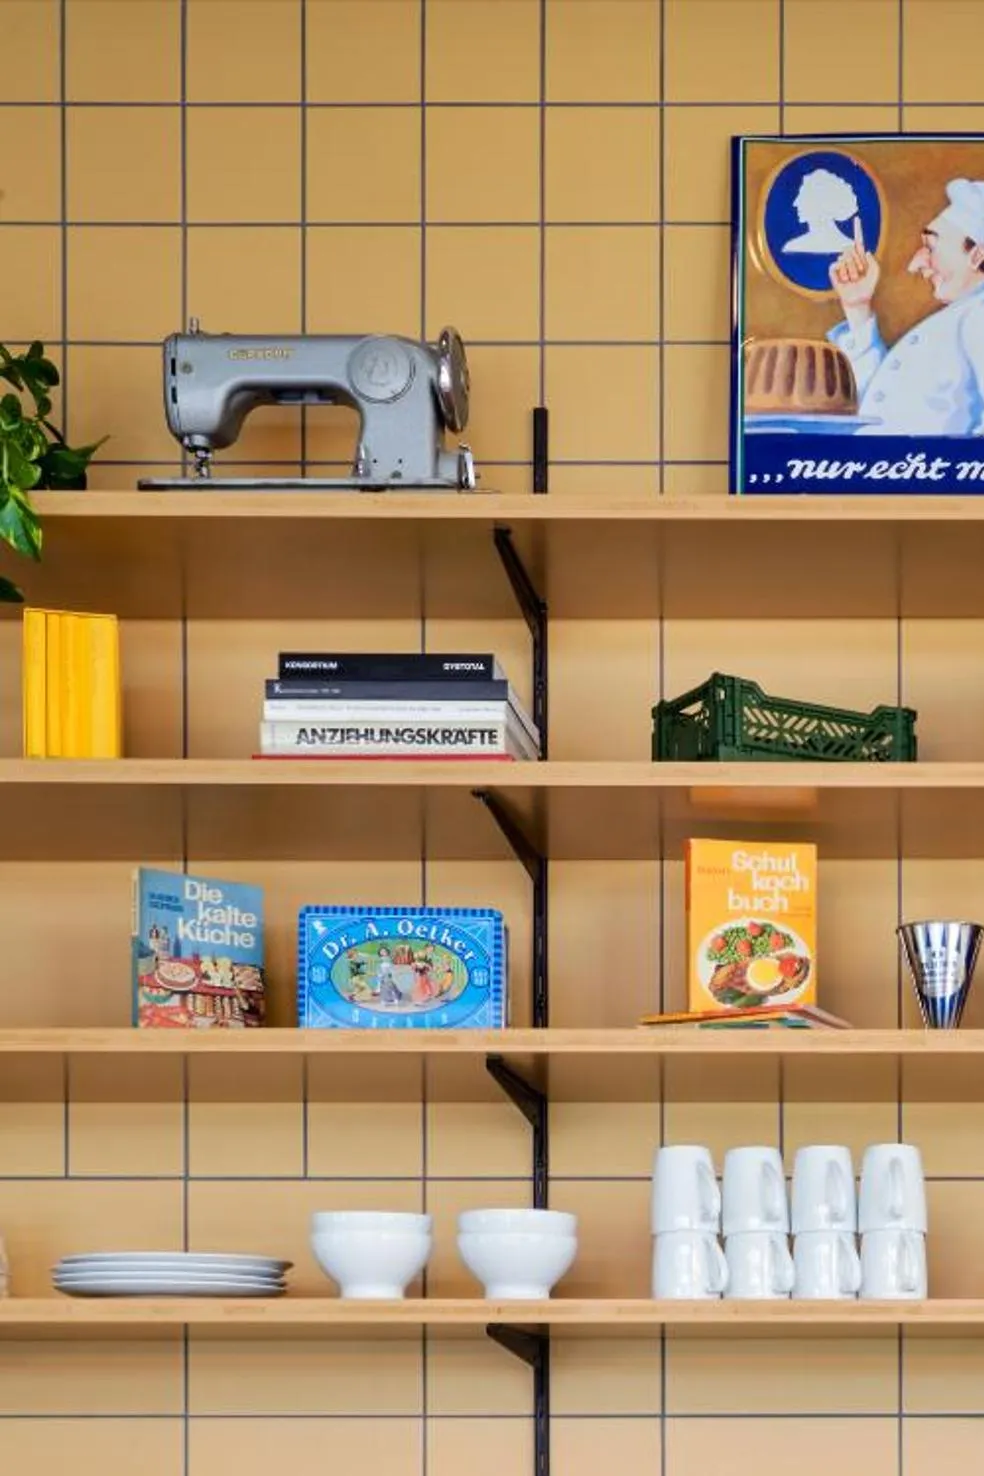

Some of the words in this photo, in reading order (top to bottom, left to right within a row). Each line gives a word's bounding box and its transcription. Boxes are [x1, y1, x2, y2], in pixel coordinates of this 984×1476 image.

[865, 453, 952, 480] echt
[296, 727, 499, 745] ANZIEHUNGSKRÄFTE
[185, 879, 223, 904] Die
[752, 869, 810, 891] koch
[728, 888, 789, 912] buch
[199, 901, 257, 928] kalte
[177, 917, 255, 948] Küche
[322, 934, 357, 960] Dr.
[365, 921, 389, 939] A.
[397, 919, 477, 960] Oetker
